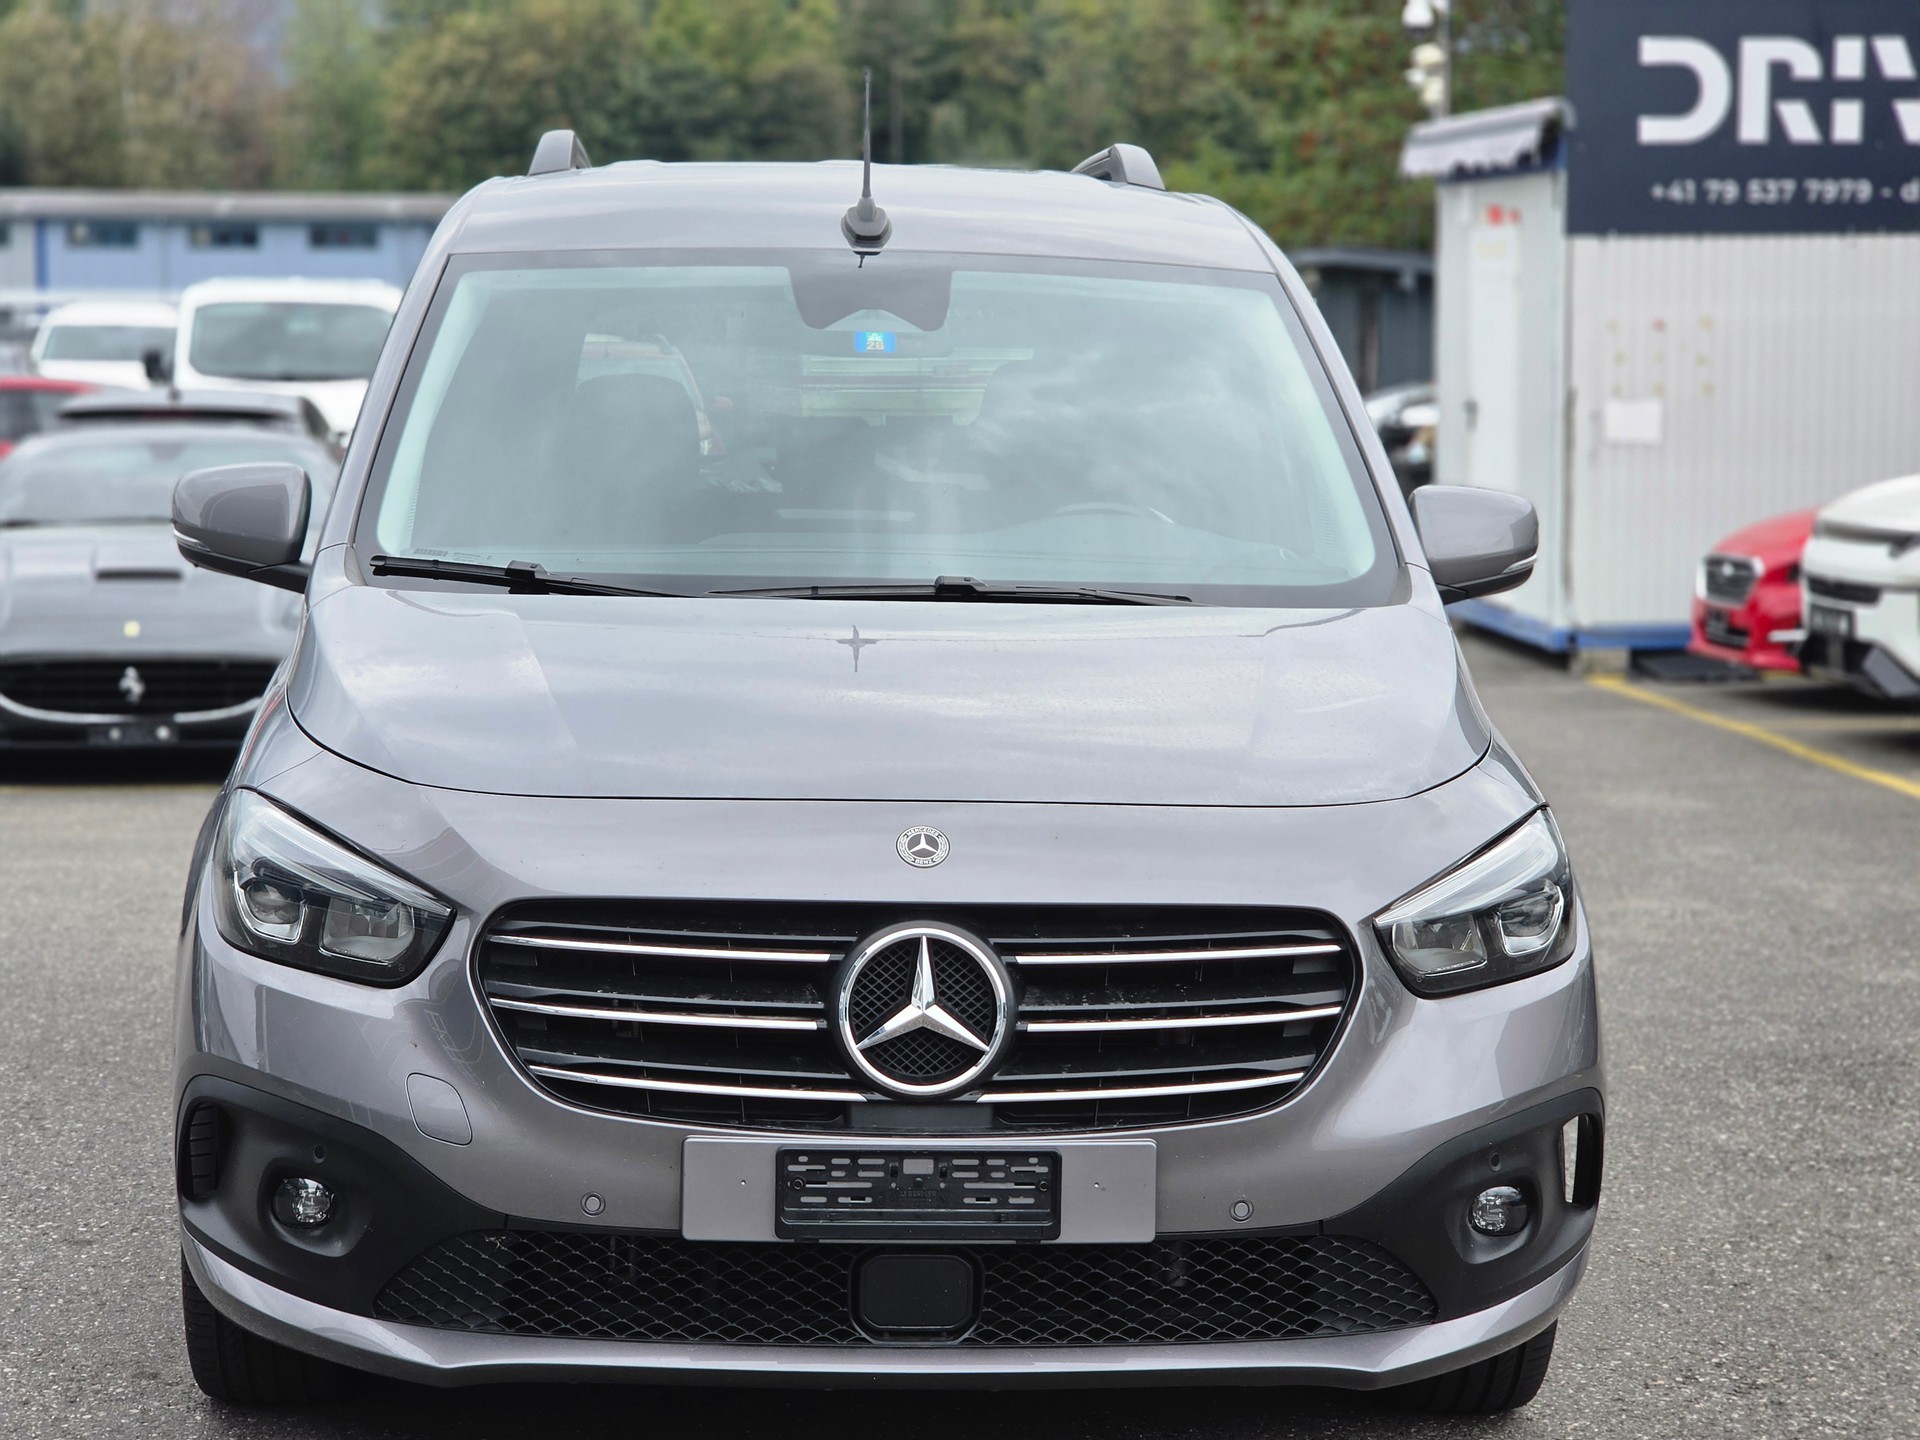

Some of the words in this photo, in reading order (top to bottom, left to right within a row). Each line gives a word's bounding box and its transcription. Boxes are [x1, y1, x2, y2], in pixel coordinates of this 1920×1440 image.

[1649, 177, 1697, 205] +41
[1702, 177, 1740, 205] 79
[1746, 177, 1798, 205] 537
[1803, 177, 1873, 205] 7979
